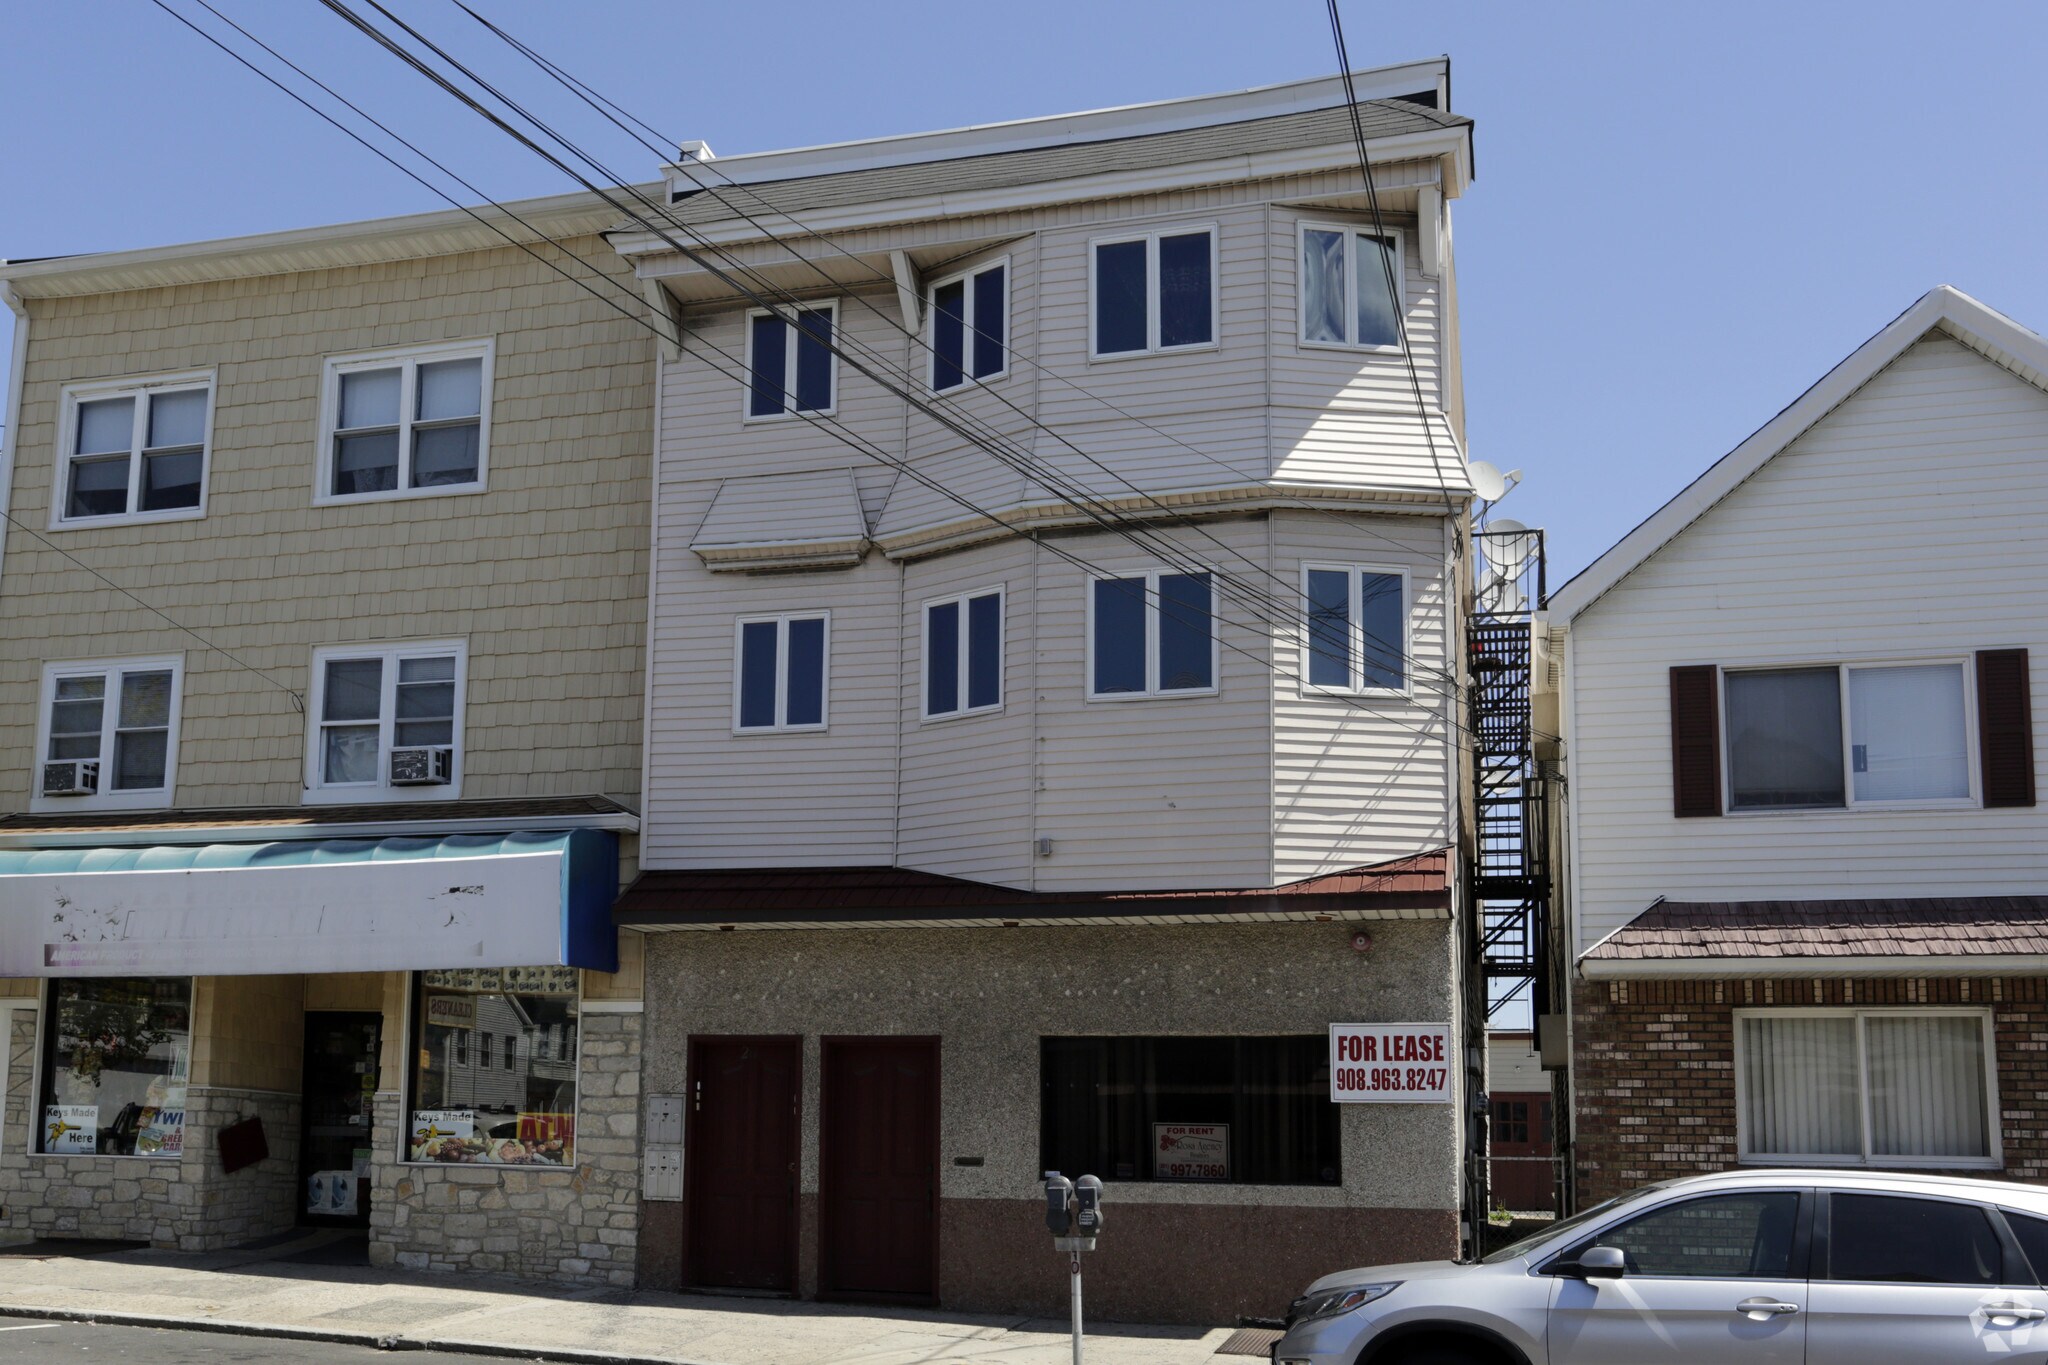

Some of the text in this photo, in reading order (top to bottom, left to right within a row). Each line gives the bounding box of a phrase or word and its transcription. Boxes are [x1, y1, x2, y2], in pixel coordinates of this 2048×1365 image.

[51, 950, 99, 962] AMERICAN
[1338, 1035, 1444, 1061] FOR LEASE
[1337, 1068, 1447, 1090] 908.963.8247
[47, 1108, 96, 1119] Keys Made
[414, 1112, 471, 1124] Keys Made
[69, 1132, 93, 1143] Here
[1198, 1141, 1224, 1153] Agency
